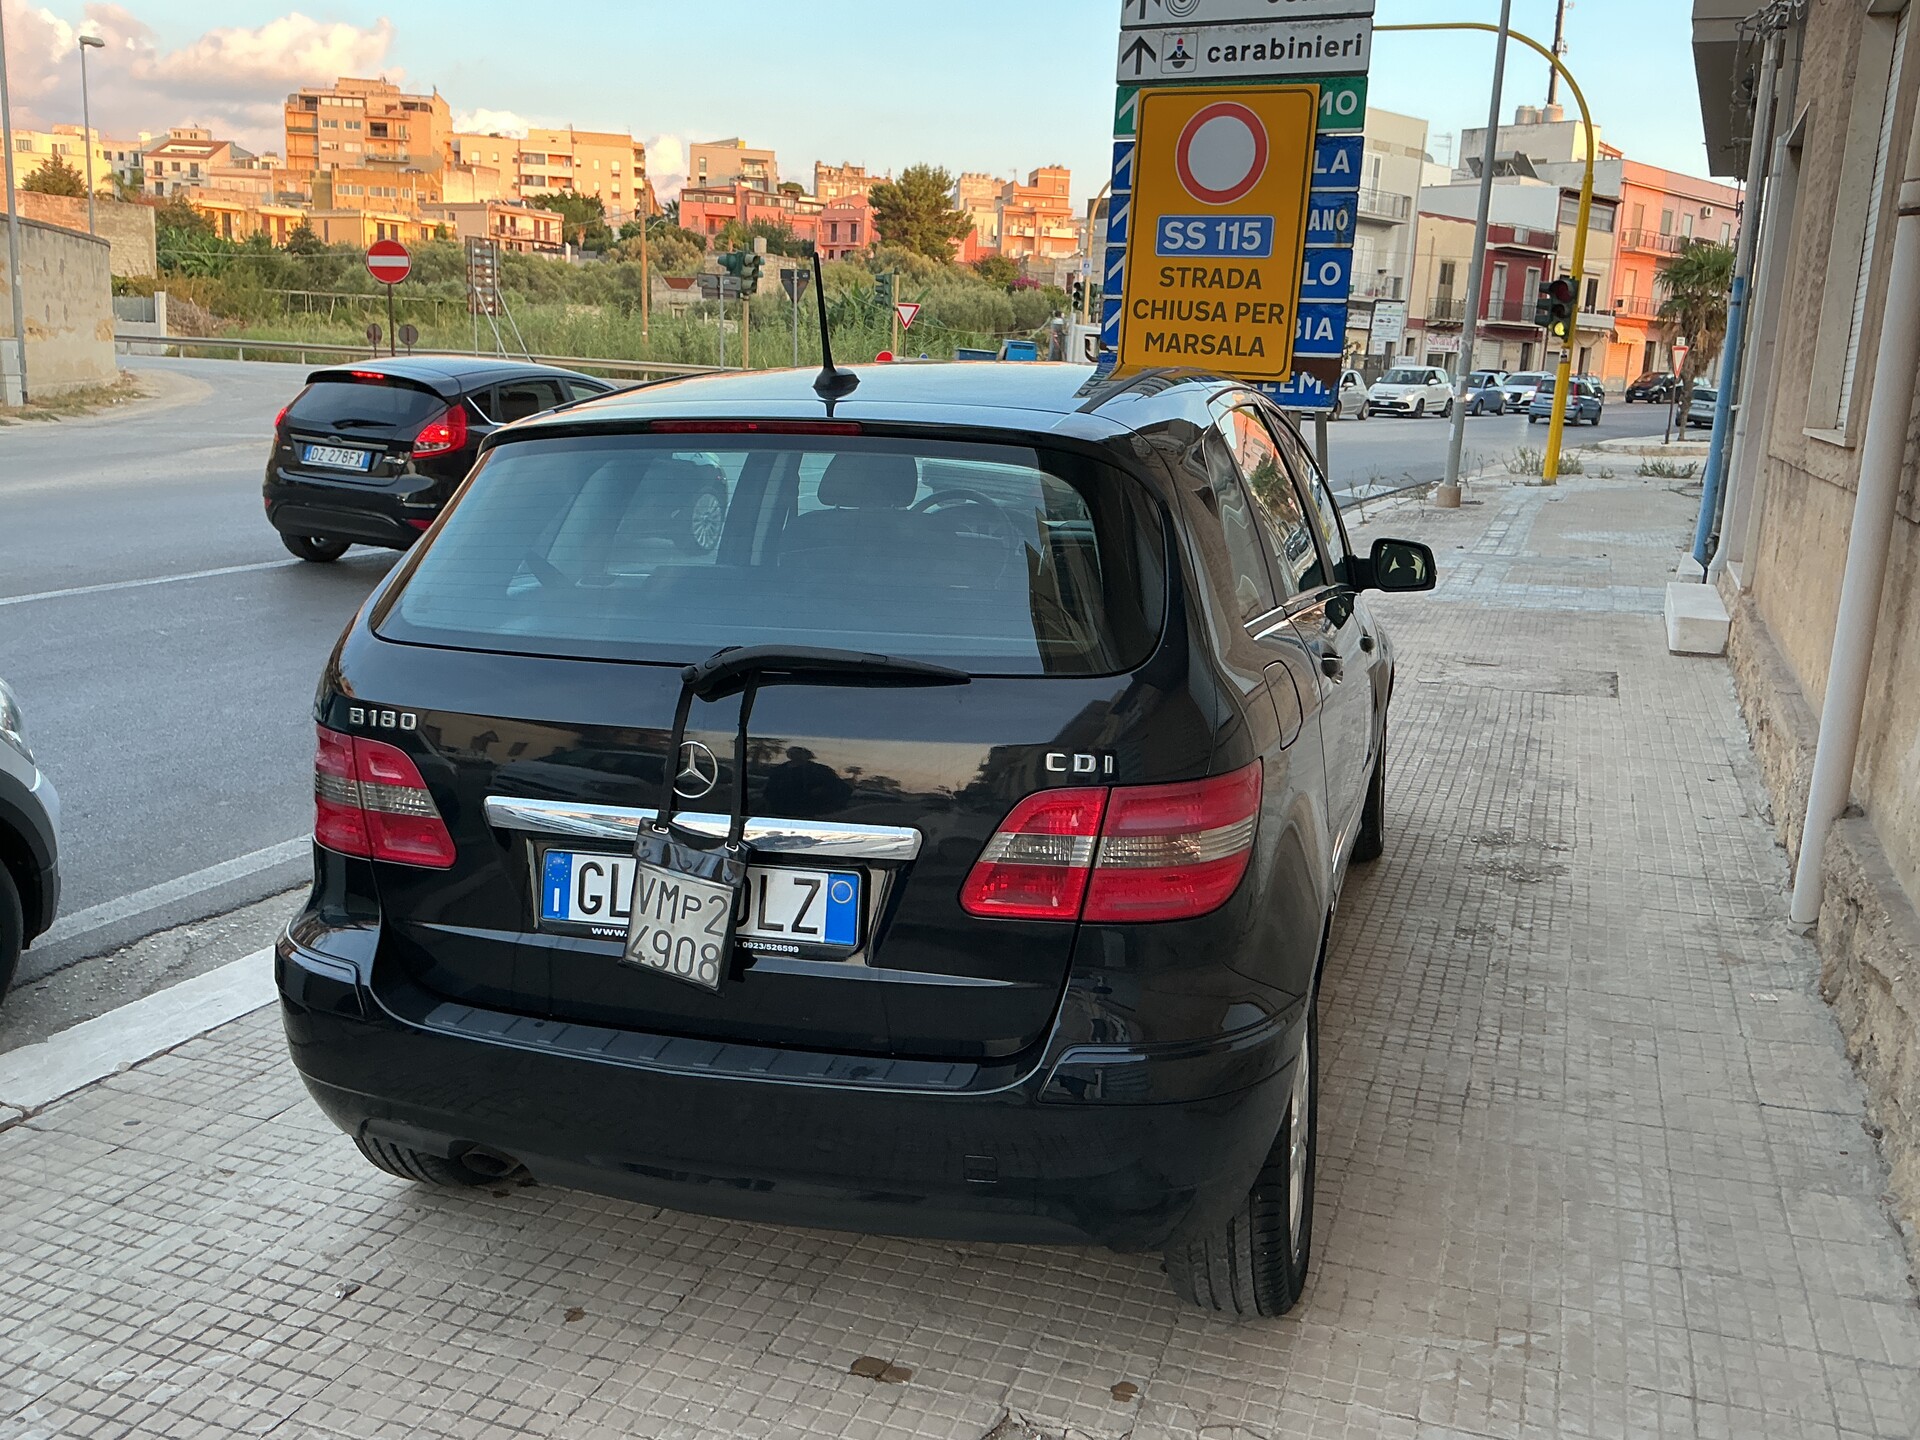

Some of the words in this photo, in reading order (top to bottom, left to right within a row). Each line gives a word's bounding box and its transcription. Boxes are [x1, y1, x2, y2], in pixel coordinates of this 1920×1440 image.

[1207, 33, 1363, 63] carabinieri
[1308, 209, 1349, 231] ANO
[1162, 221, 1206, 250] SS
[1215, 222, 1262, 250] 115
[1159, 266, 1262, 290] STRADA
[1302, 261, 1341, 286] LO
[1133, 299, 1227, 323] CHIUSA
[1235, 302, 1285, 324] PER
[1144, 332, 1265, 358] MARSALA
[1045, 752, 1114, 775] CDI
[632, 925, 720, 984] 4908
[742, 941, 799, 953] 0923/526599
